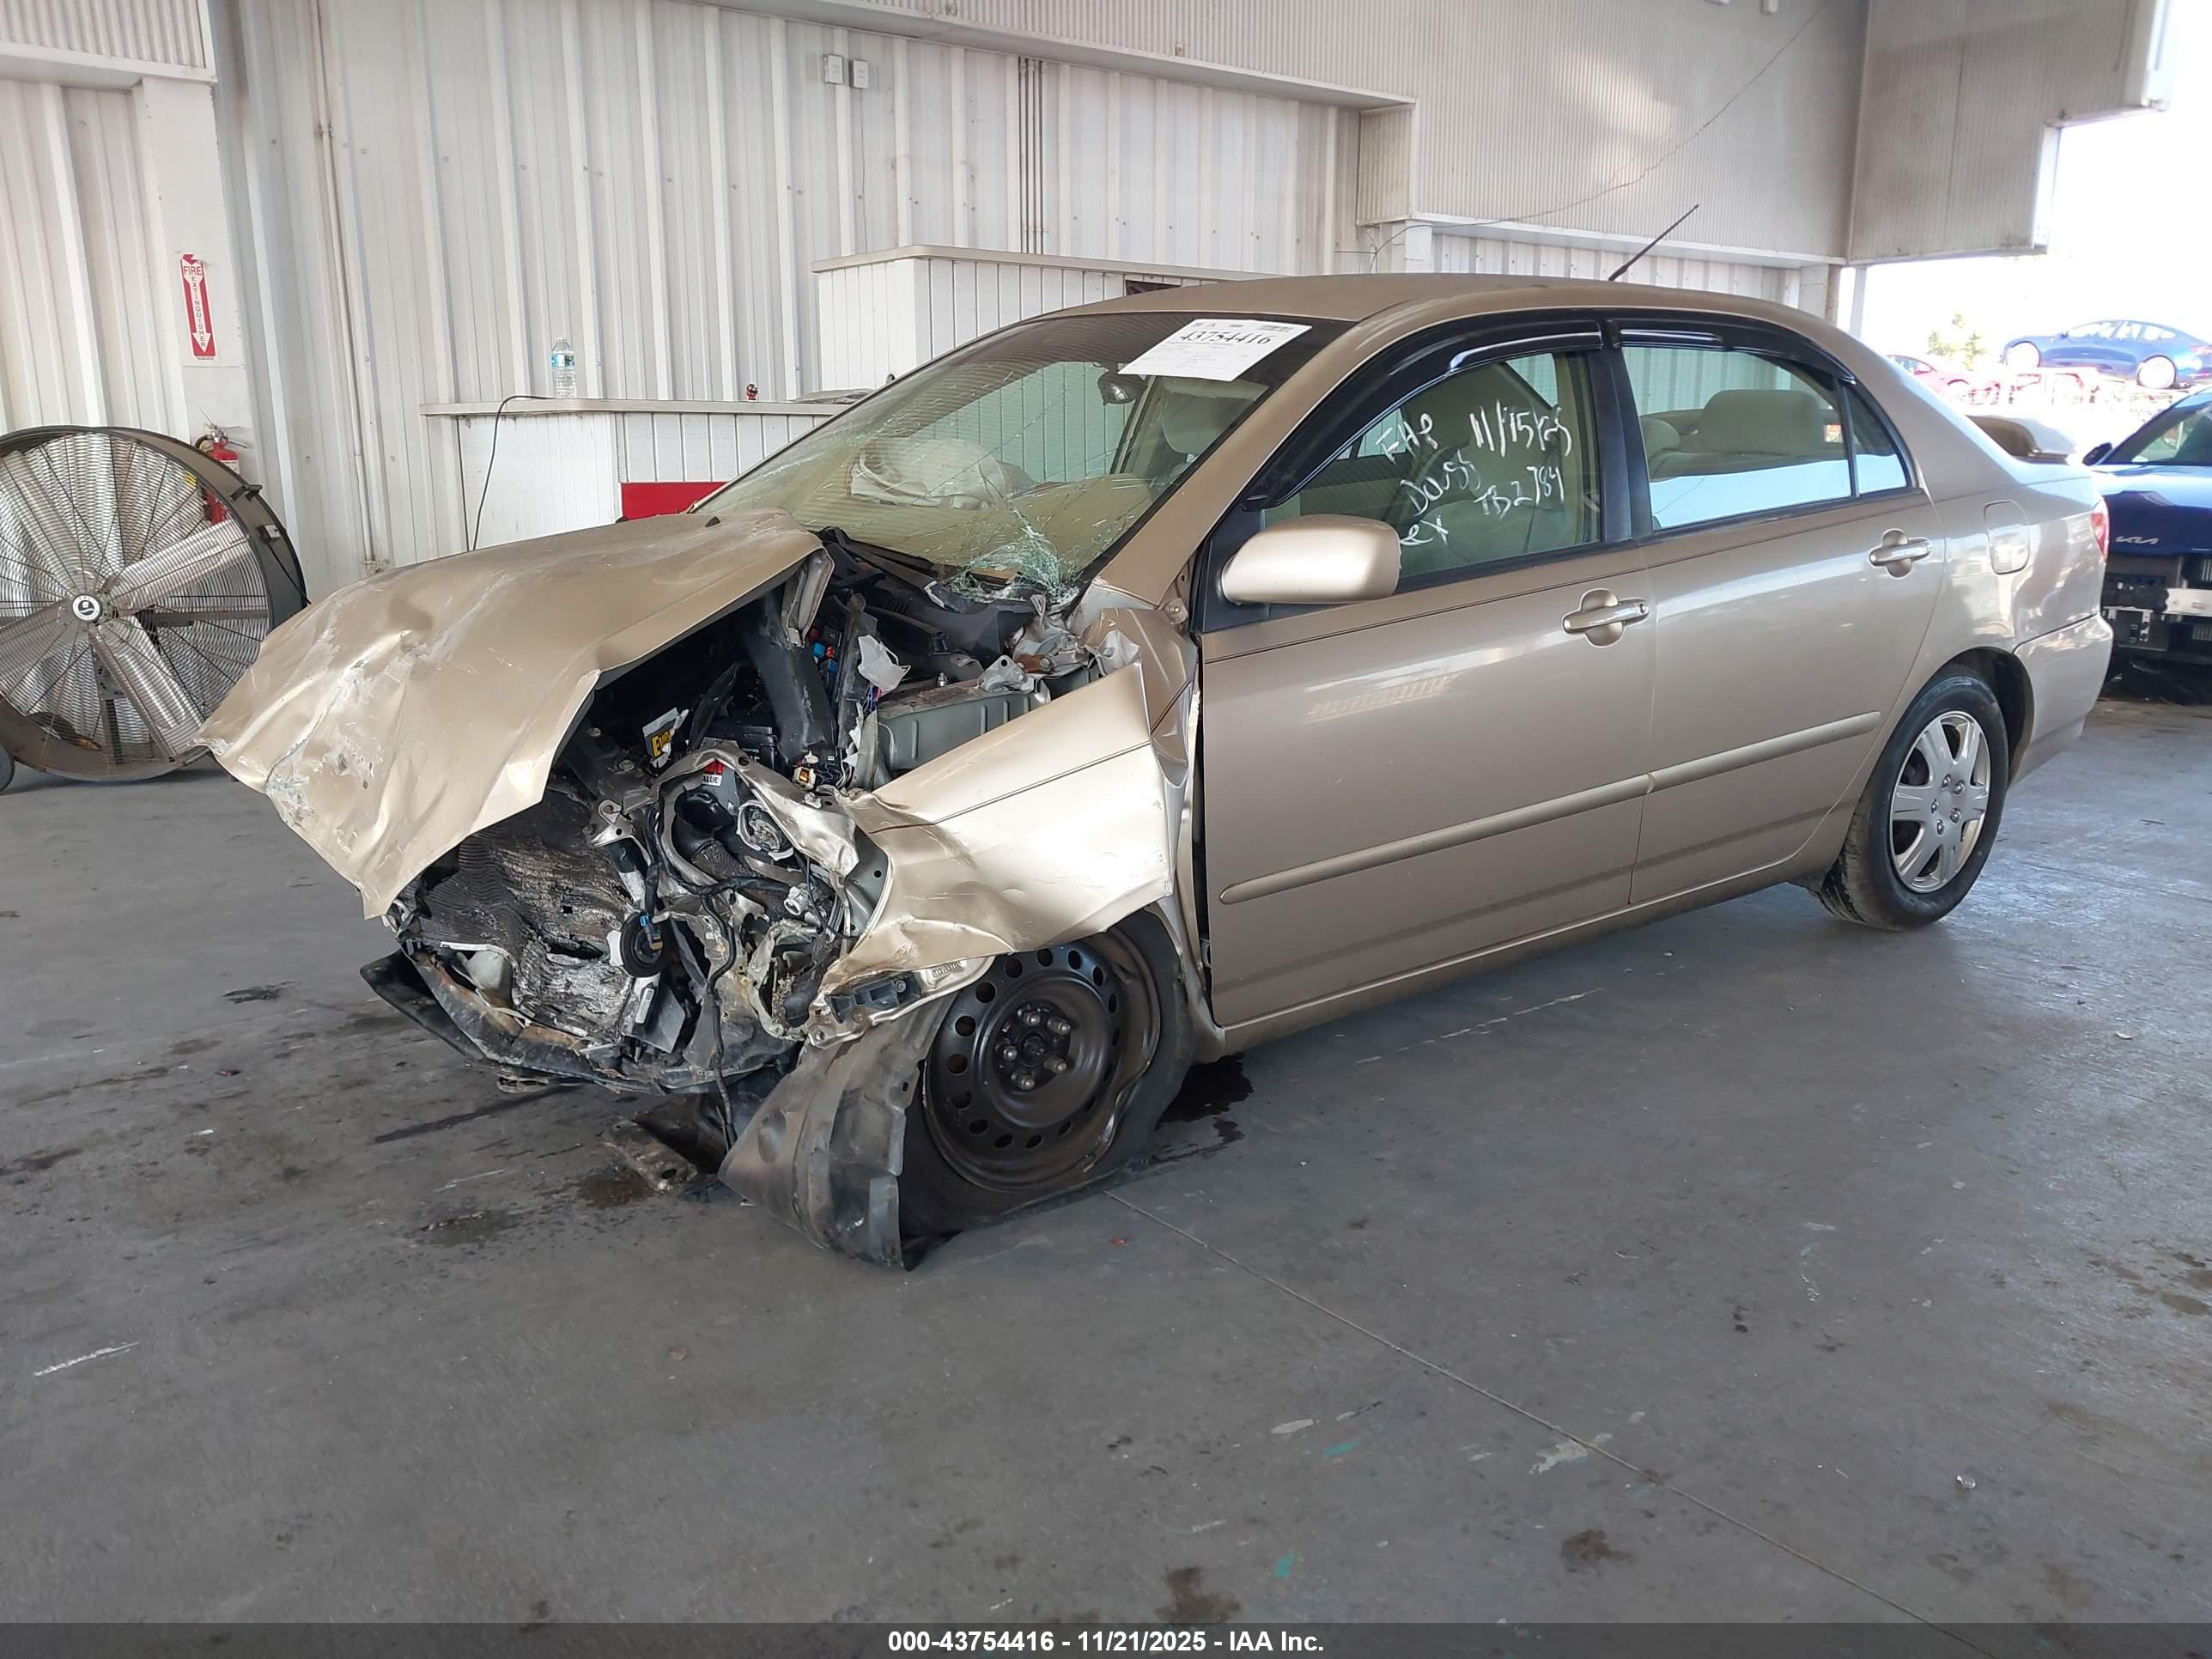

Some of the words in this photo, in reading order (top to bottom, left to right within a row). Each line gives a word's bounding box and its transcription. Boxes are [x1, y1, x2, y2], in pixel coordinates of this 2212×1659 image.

[183, 266, 203, 276] FIRE
[191, 276, 206, 348] EXTINGUISHER
[1179, 330, 1276, 345] 43754416
